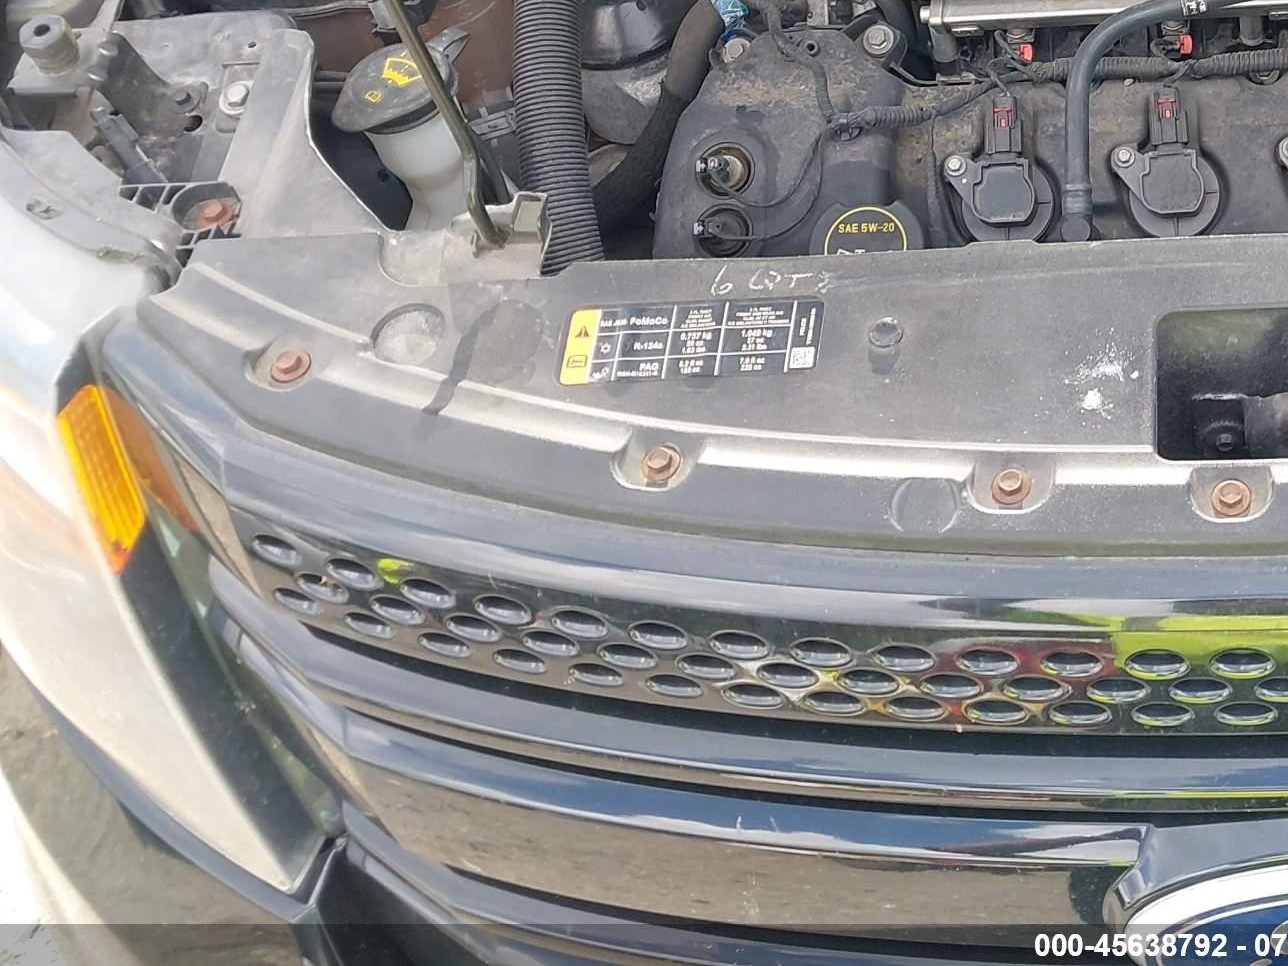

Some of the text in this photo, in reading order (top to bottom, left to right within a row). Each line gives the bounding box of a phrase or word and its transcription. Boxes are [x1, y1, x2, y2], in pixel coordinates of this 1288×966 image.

[838, 222, 895, 234] SAE 5W-20
[629, 316, 668, 326] FoMoCo
[633, 341, 664, 350] R-134a
[639, 362, 659, 372] PAG
